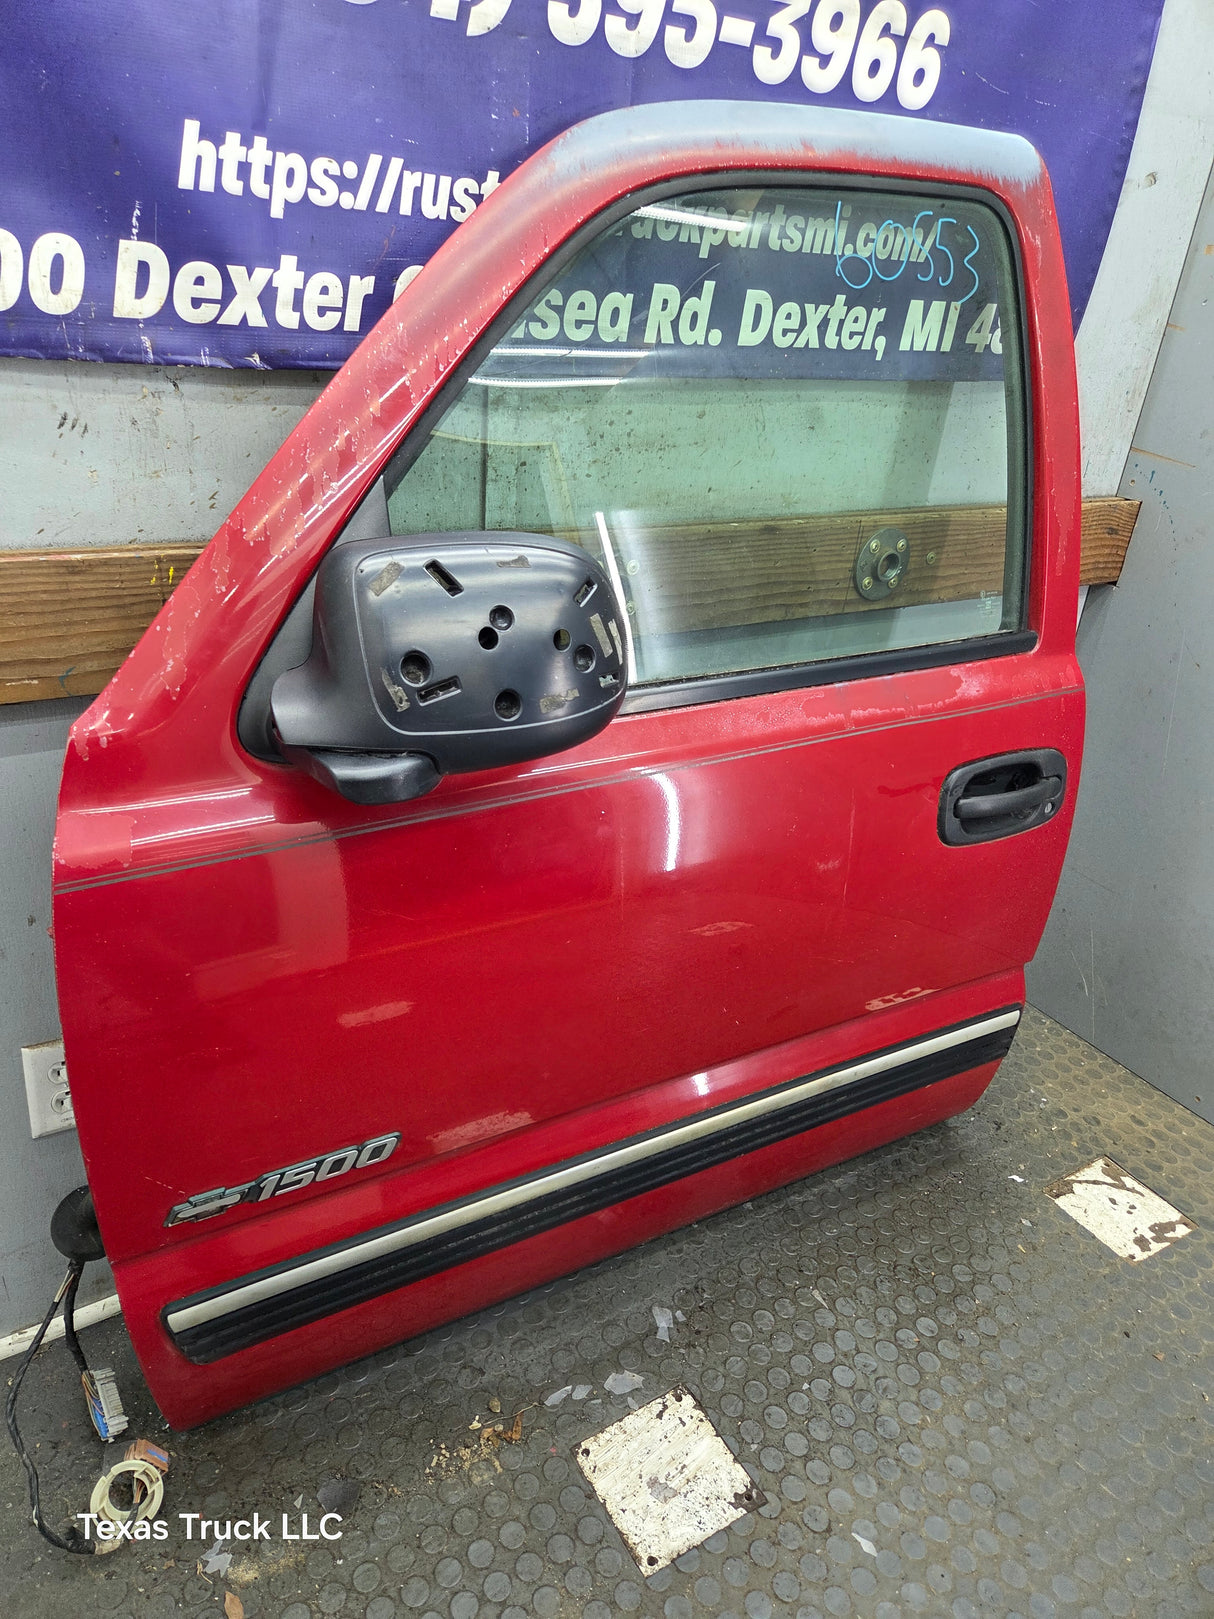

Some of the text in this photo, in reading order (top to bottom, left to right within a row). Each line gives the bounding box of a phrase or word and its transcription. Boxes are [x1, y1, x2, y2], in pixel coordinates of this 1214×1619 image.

[113, 239, 375, 332] Dexter
[511, 288, 634, 343] sea
[643, 280, 722, 346] Rd.
[738, 289, 887, 361] Dexter,
[899, 299, 962, 352] MI
[258, 1136, 399, 1203] 1500
